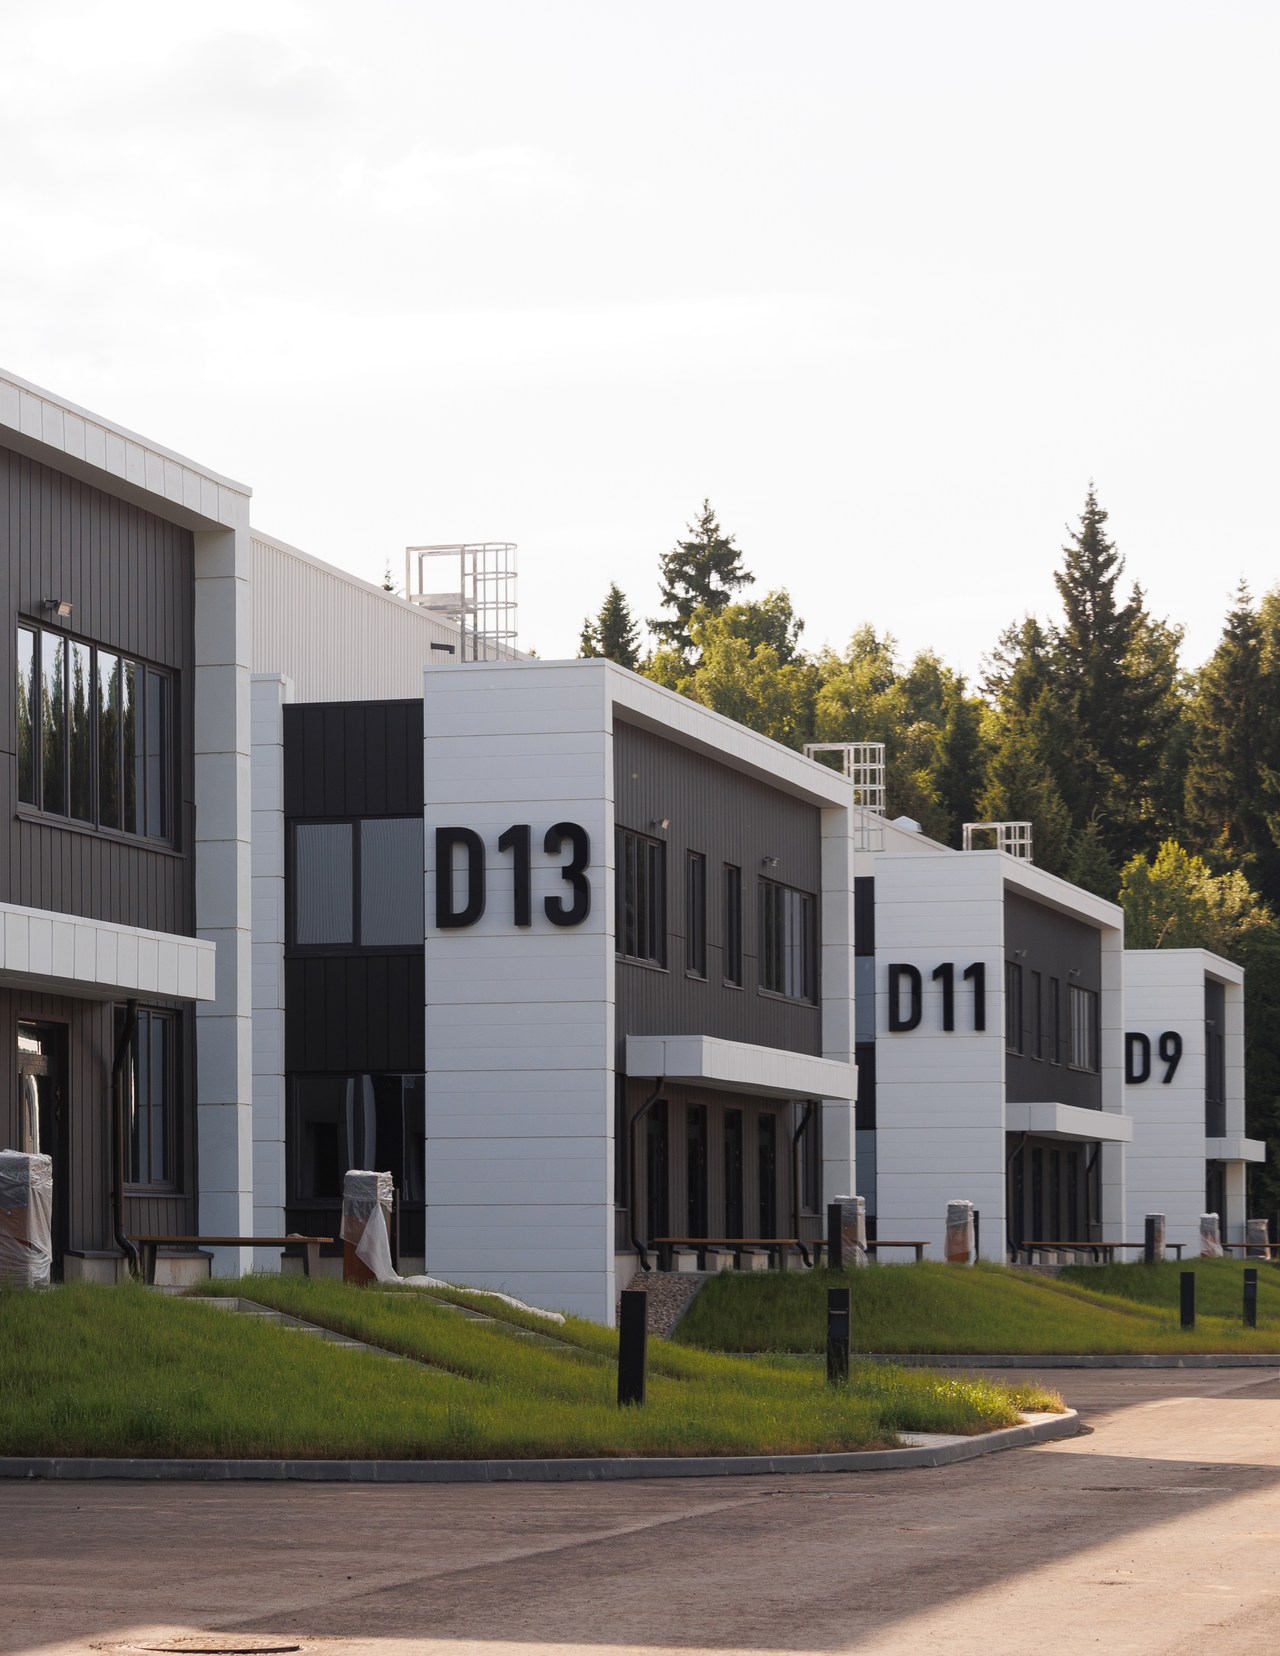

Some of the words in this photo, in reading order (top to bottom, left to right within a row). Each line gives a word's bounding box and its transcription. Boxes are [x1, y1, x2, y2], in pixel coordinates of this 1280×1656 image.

[435, 822, 591, 930] D13
[888, 962, 986, 1033] D11
[1125, 1031, 1183, 1085] D9
